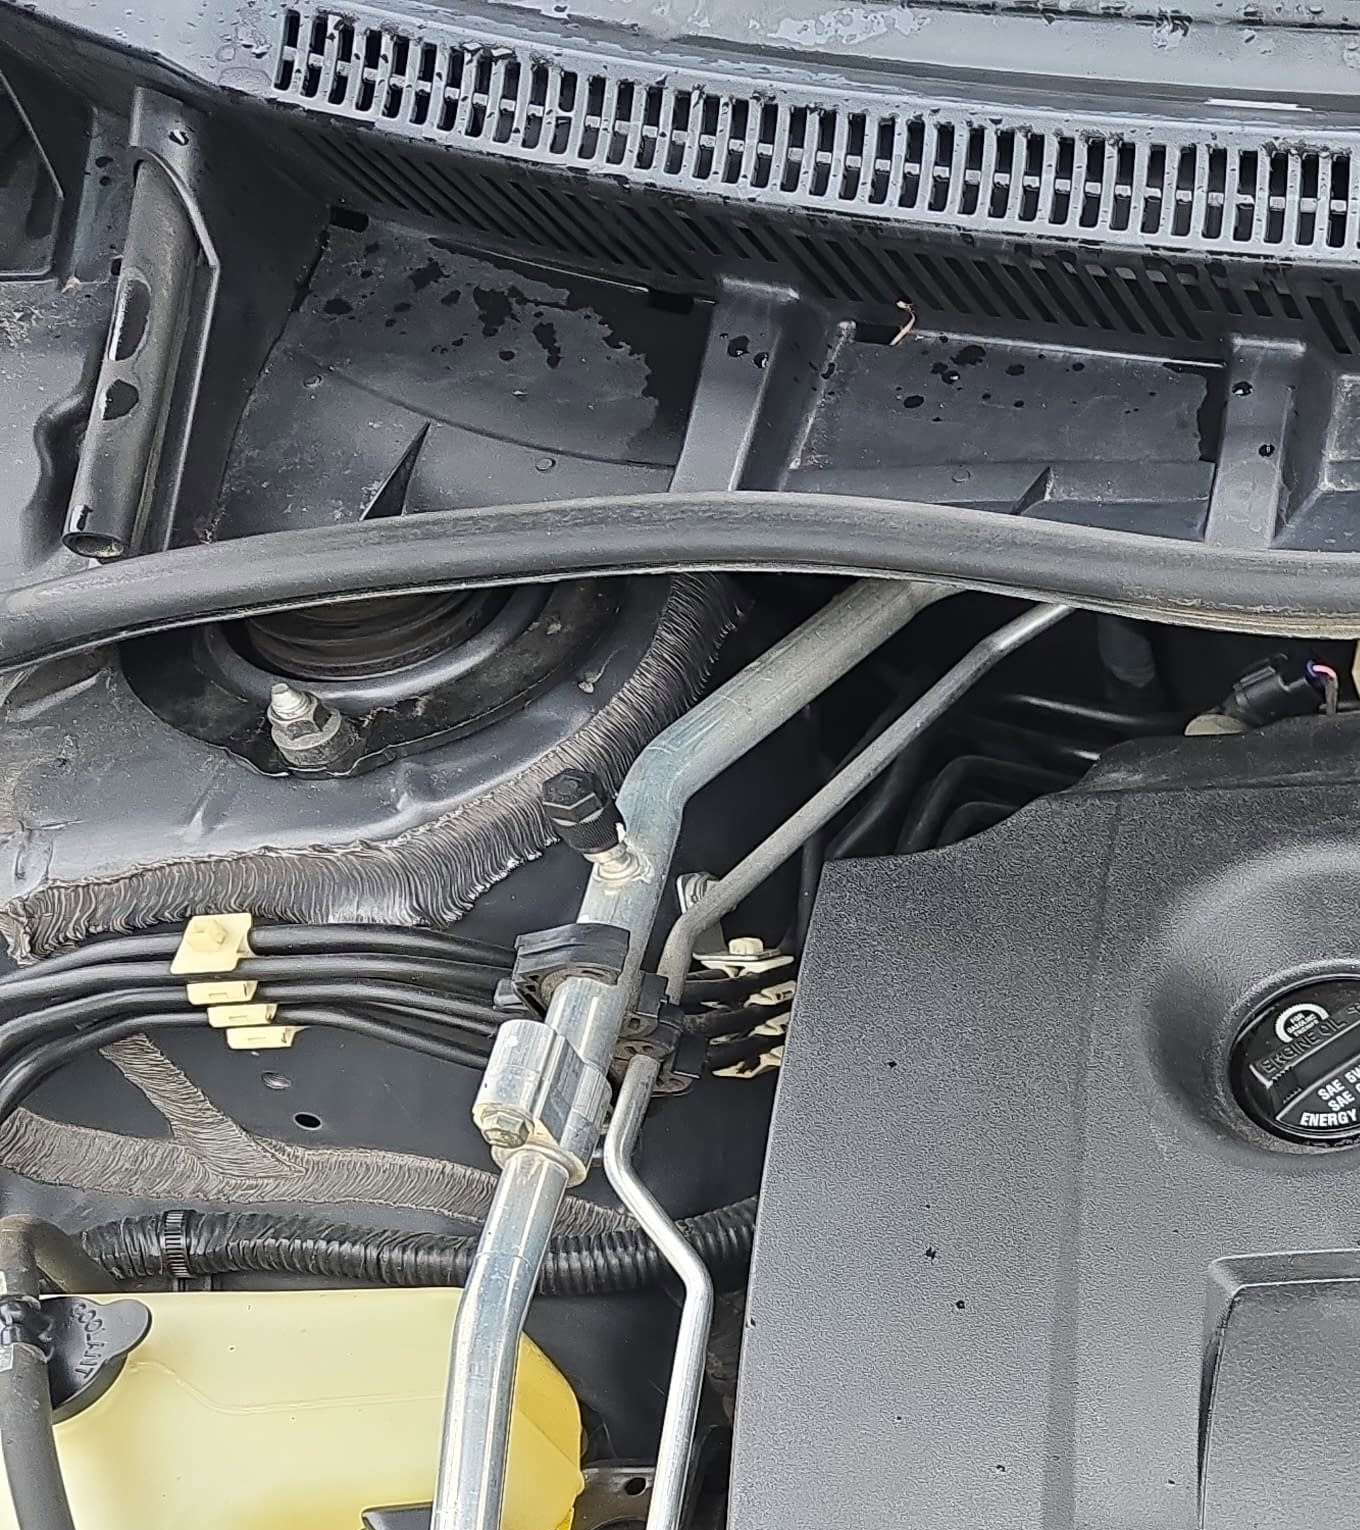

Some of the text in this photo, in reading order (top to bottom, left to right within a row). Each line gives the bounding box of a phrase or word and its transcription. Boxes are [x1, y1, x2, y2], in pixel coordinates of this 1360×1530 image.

[1317, 1079, 1345, 1101] SAE
[1328, 1090, 1355, 1112] SAE
[1300, 1108, 1357, 1127] ENERGY
